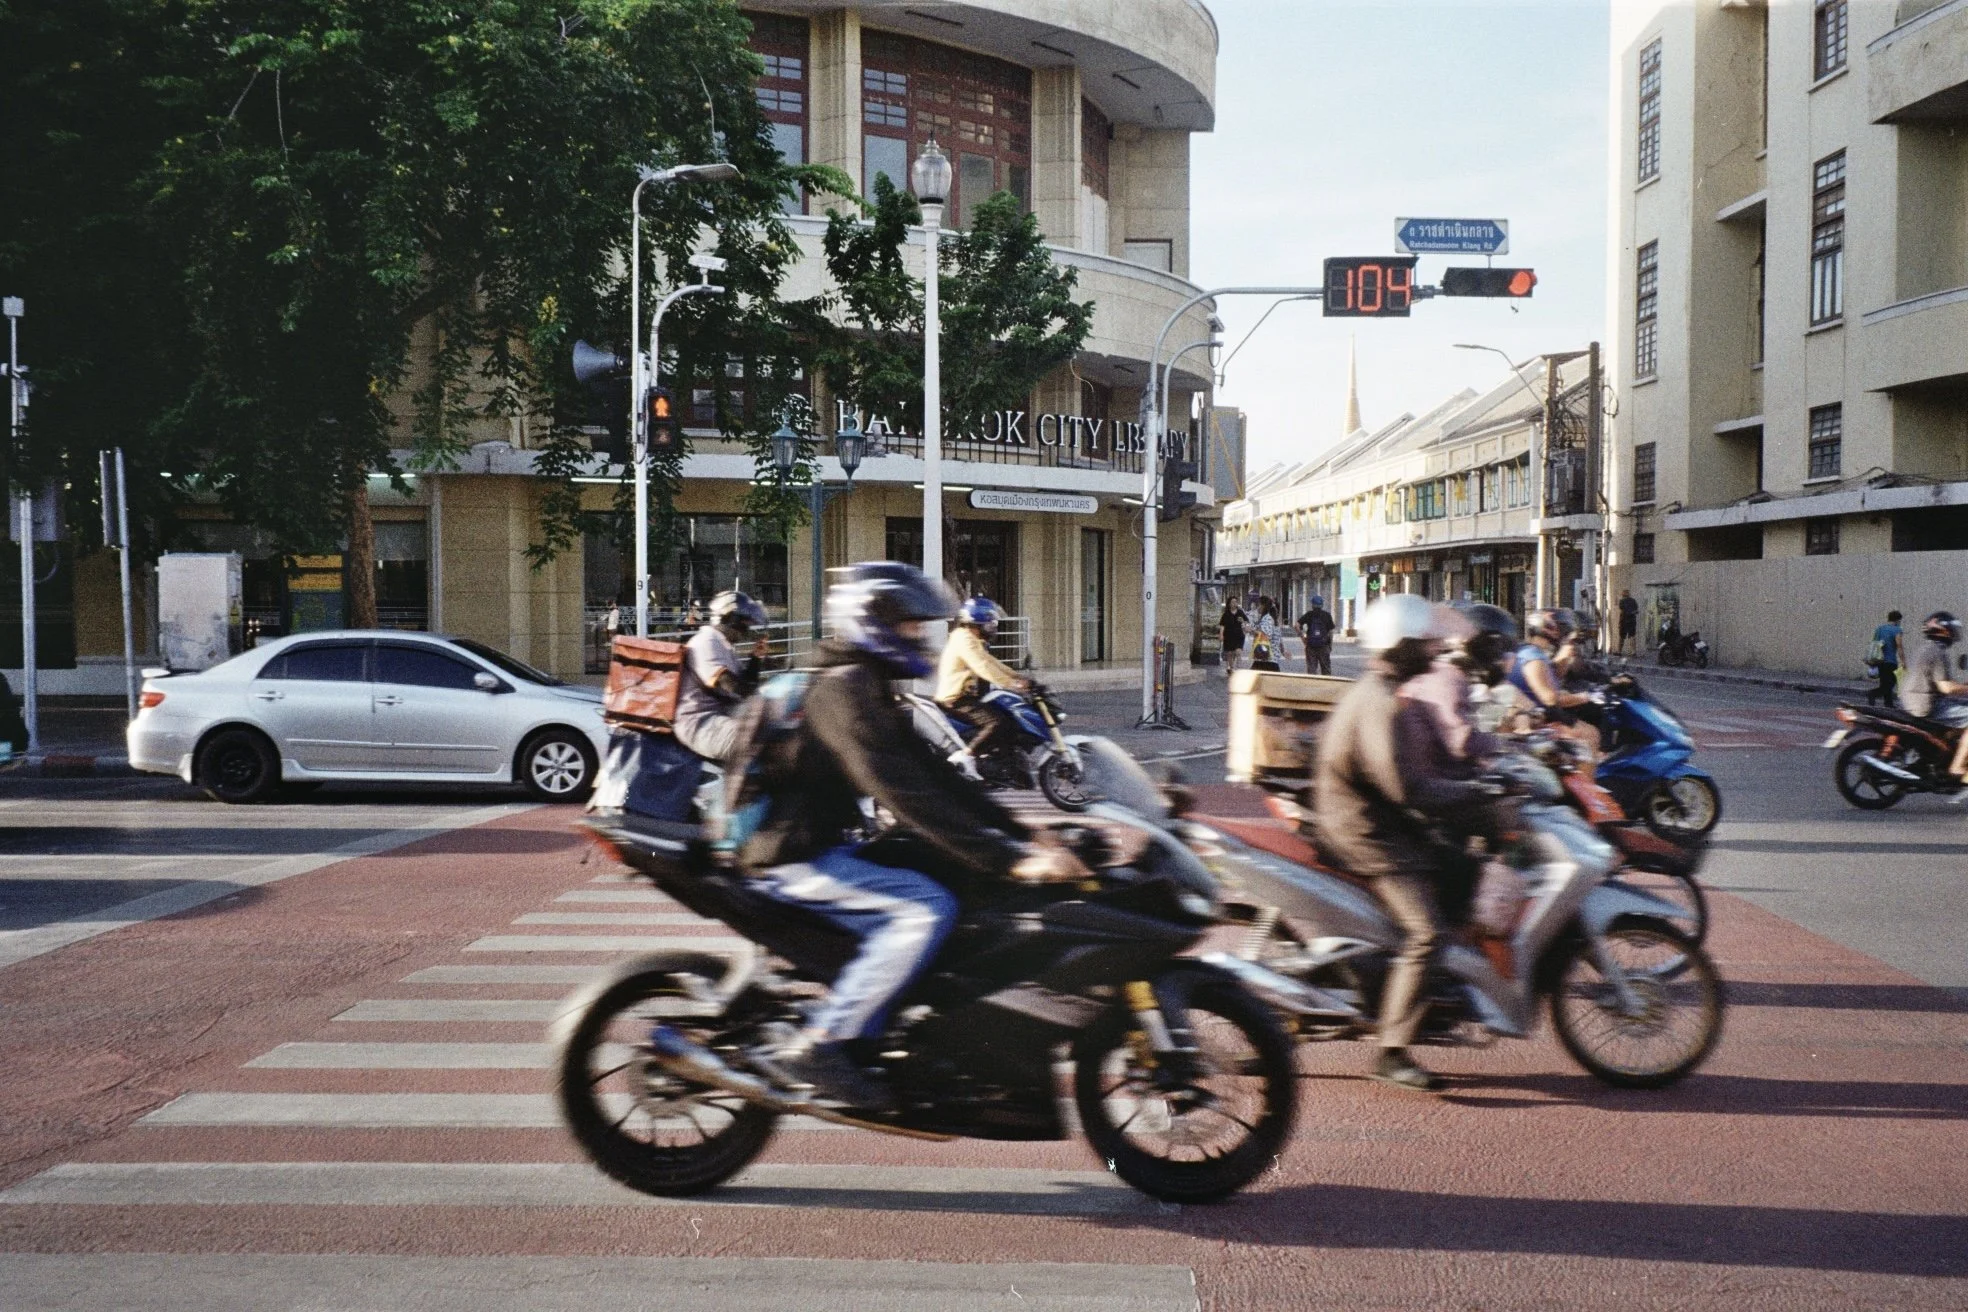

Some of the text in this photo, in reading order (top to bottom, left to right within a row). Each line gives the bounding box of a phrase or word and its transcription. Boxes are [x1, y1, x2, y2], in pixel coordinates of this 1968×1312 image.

[1347, 264, 1411, 312] 104
[837, 399, 1189, 461] BAOK CITY LIBRY
